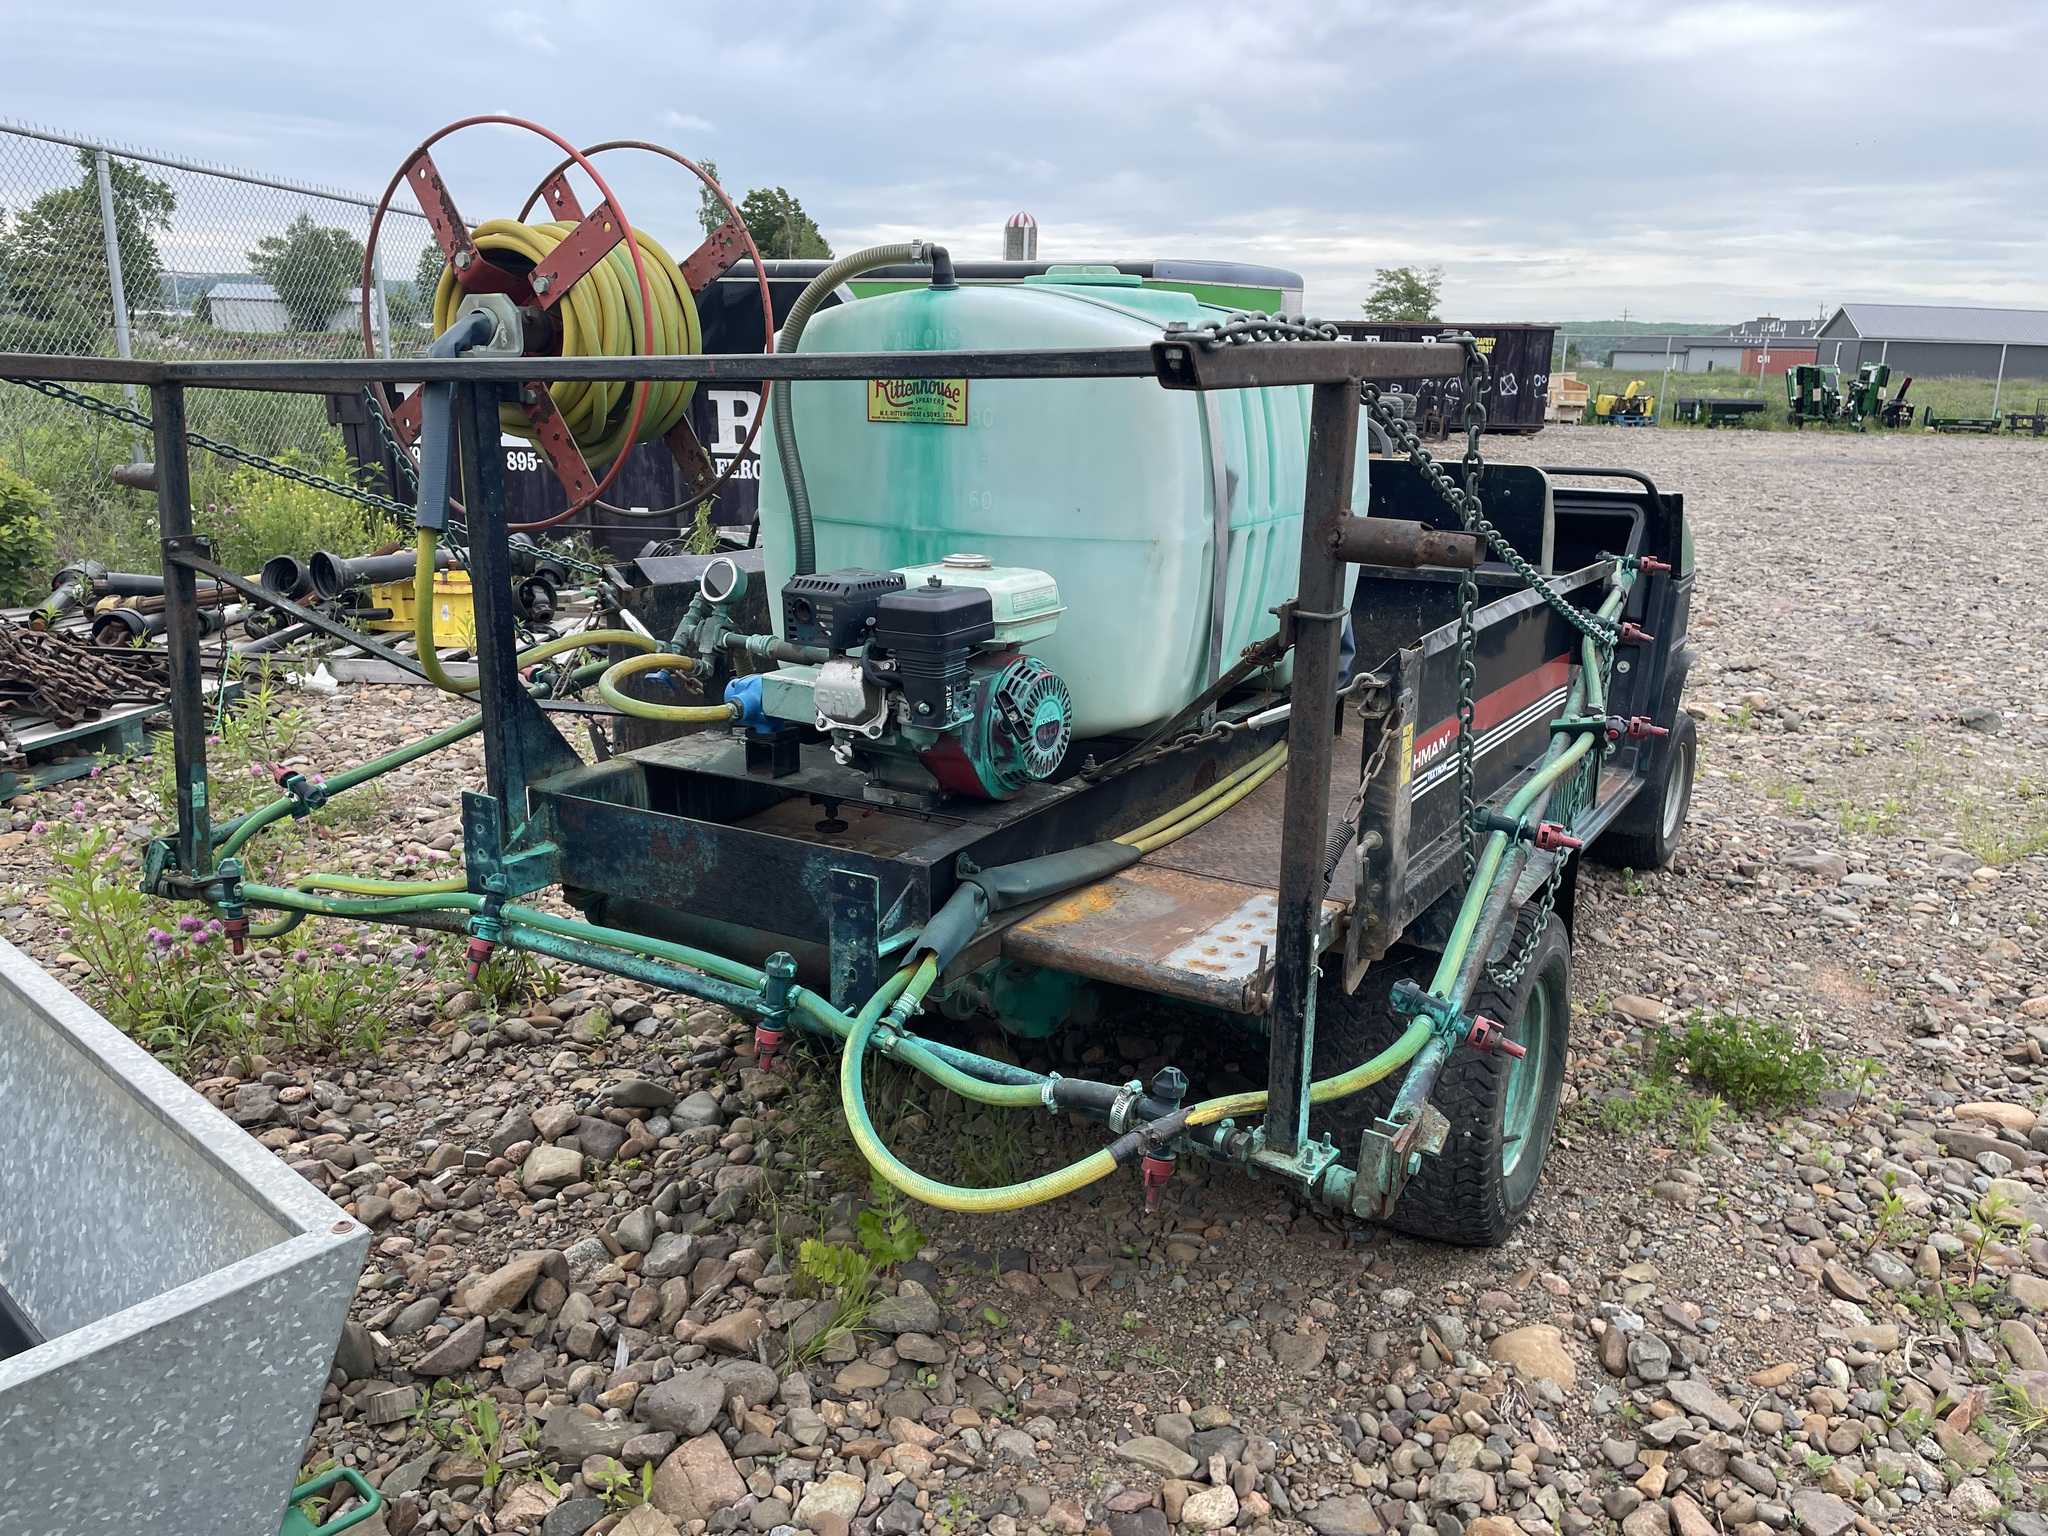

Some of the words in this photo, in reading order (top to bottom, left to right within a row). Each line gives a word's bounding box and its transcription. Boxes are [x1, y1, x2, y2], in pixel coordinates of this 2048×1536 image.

[1475, 336, 1497, 346] SAFETY
[873, 379, 961, 406] Rittenhouse
[915, 398, 945, 406] SPRAYERS
[970, 408, 993, 427] 80
[506, 451, 544, 472] 895-
[969, 490, 992, 510] 60
